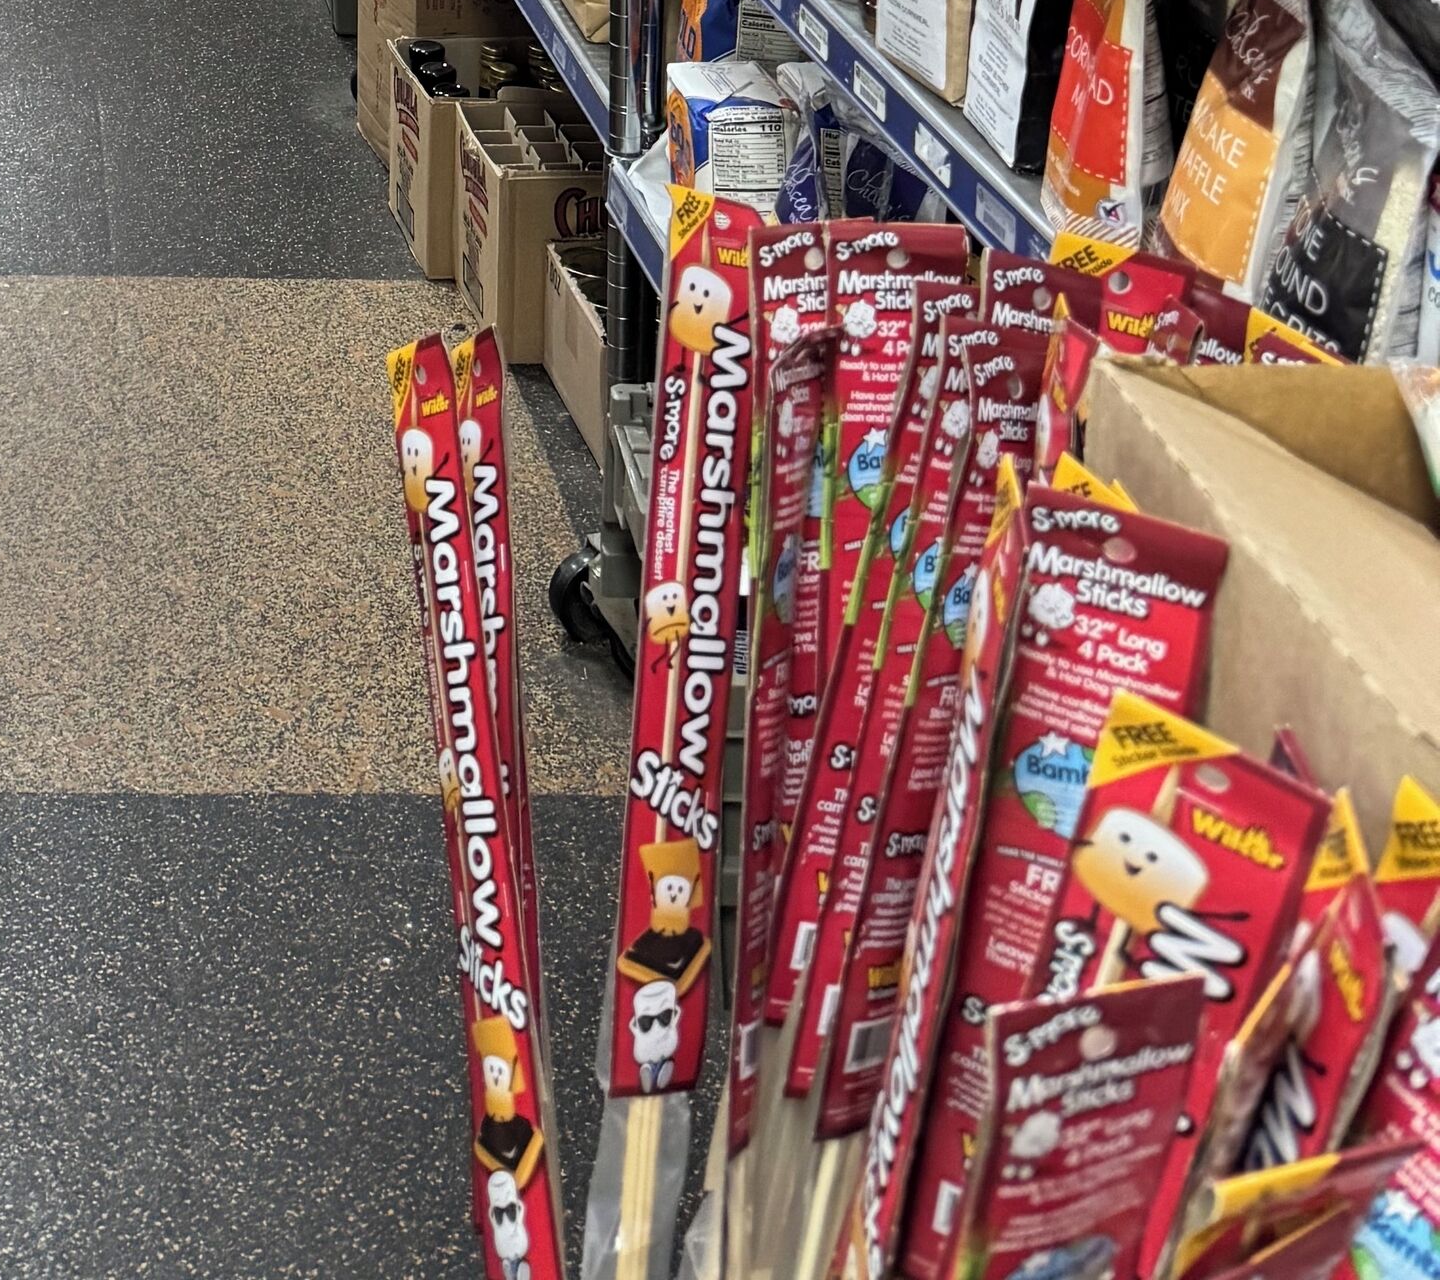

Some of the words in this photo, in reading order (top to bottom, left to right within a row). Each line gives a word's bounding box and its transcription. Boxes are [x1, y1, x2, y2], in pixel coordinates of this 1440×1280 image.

[742, 20, 775, 29] Calories
[760, 123, 782, 133] 110
[678, 190, 702, 223] FREE
[759, 230, 815, 267] S-more
[835, 230, 899, 260] S-more
[992, 266, 1045, 294] S-more
[922, 291, 973, 322] S-more
[948, 329, 999, 358] S-more
[973, 353, 1015, 387] S-more
[658, 376, 686, 459] S-more
[999, 420, 1030, 441] Sticks
[665, 495, 678, 554] greatest
[1031, 507, 1121, 535] S-more
[678, 322, 751, 776] Marshmallow
[1028, 540, 1208, 609] Marshmallow
[1075, 582, 1148, 619] Sticks
[1117, 627, 1168, 659] Long
[1095, 645, 1150, 675] Pack
[424, 478, 504, 948] Marshmallow
[1113, 720, 1179, 749] FREE
[630, 749, 718, 850] Sticks
[459, 924, 529, 1032] Sticks
[1003, 1003, 1102, 1068] S-more
[1005, 1040, 1194, 1113] Marshmallow
